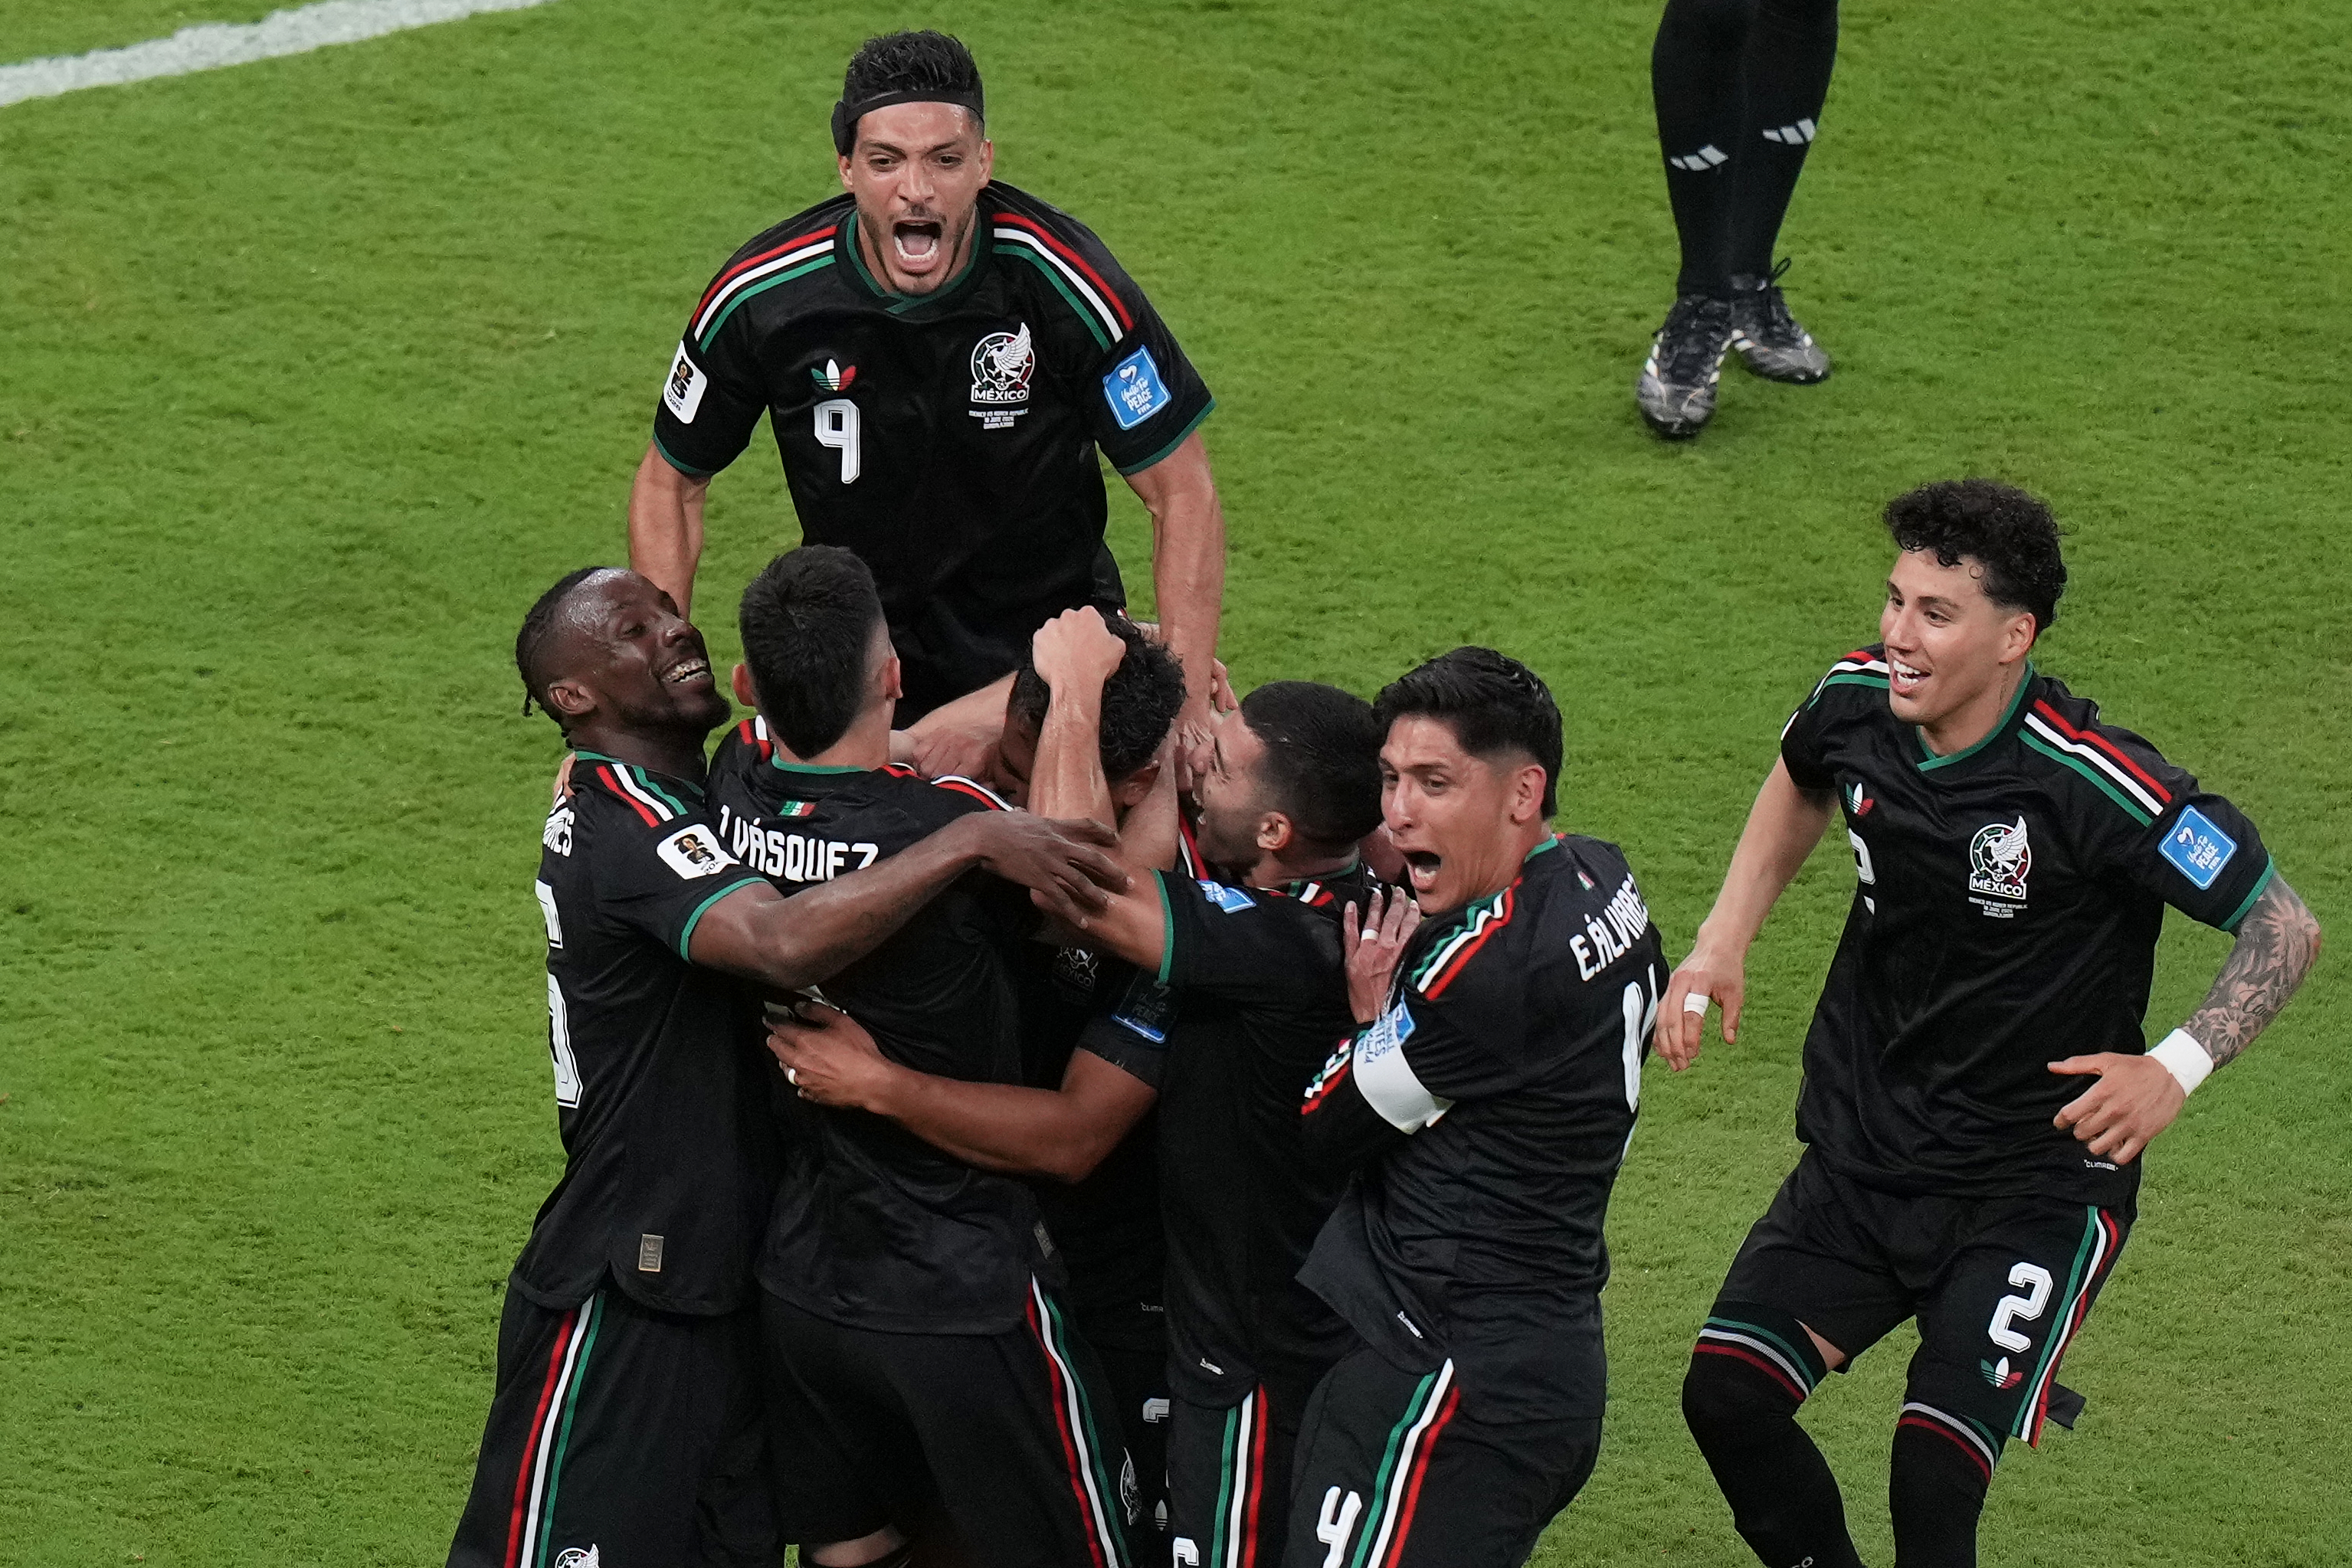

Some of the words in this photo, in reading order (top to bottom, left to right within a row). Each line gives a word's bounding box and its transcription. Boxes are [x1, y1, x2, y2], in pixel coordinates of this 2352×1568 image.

[975, 387, 1027, 401] MÉXICO
[1127, 388, 1153, 411] PEACE
[813, 398, 860, 484] 9
[2196, 842, 2219, 870] PEACE
[1972, 878, 2023, 896] MÉXICO
[1988, 1262, 2054, 1354] 2
[1316, 1485, 1363, 1568] 4
